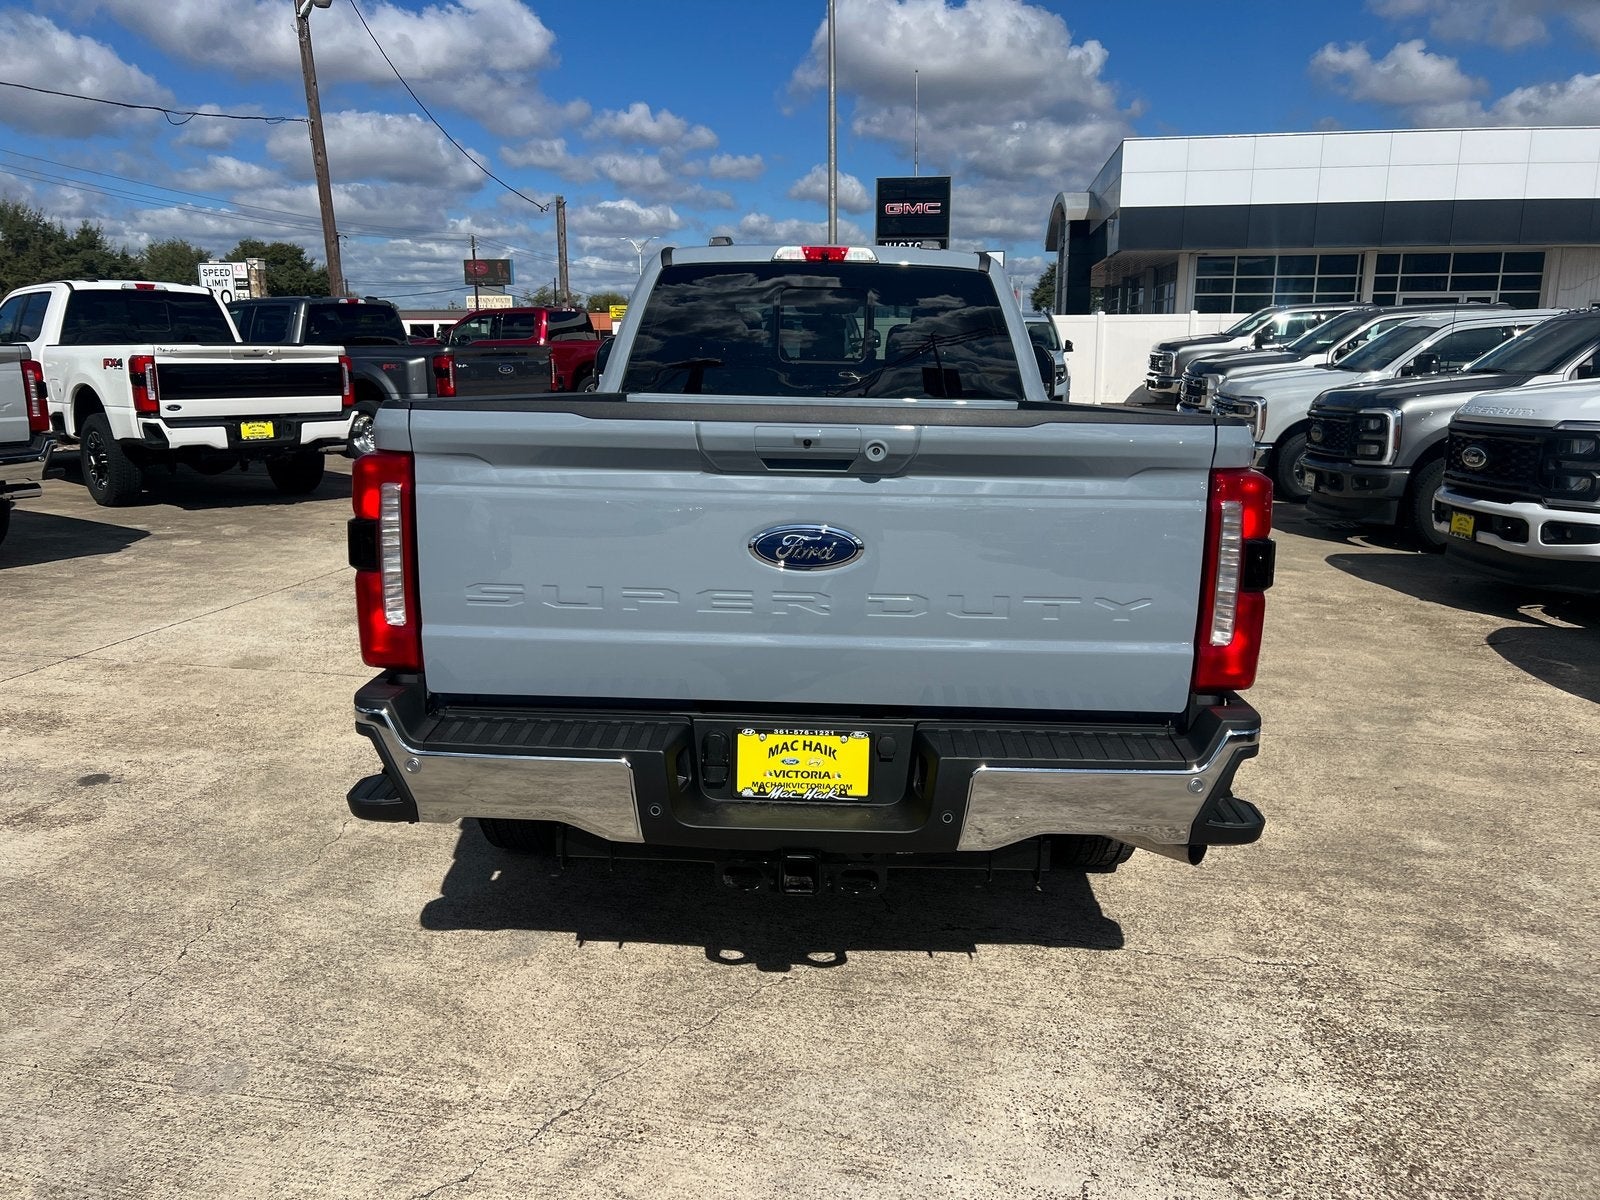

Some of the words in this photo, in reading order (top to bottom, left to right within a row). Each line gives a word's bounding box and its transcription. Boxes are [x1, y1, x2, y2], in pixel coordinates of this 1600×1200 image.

[885, 202, 941, 215] GMC
[202, 268, 231, 276] SPEED
[206, 279, 229, 287] LIMIT
[103, 358, 123, 370] FX4
[775, 534, 838, 560] Ford
[466, 582, 831, 616] SUPER
[867, 592, 1152, 622] DUTY
[768, 740, 799, 758] MAC
[802, 740, 837, 760] HAIK
[773, 769, 831, 779] VICTORIA
[767, 787, 796, 799] Mac
[802, 787, 840, 799] Haik
